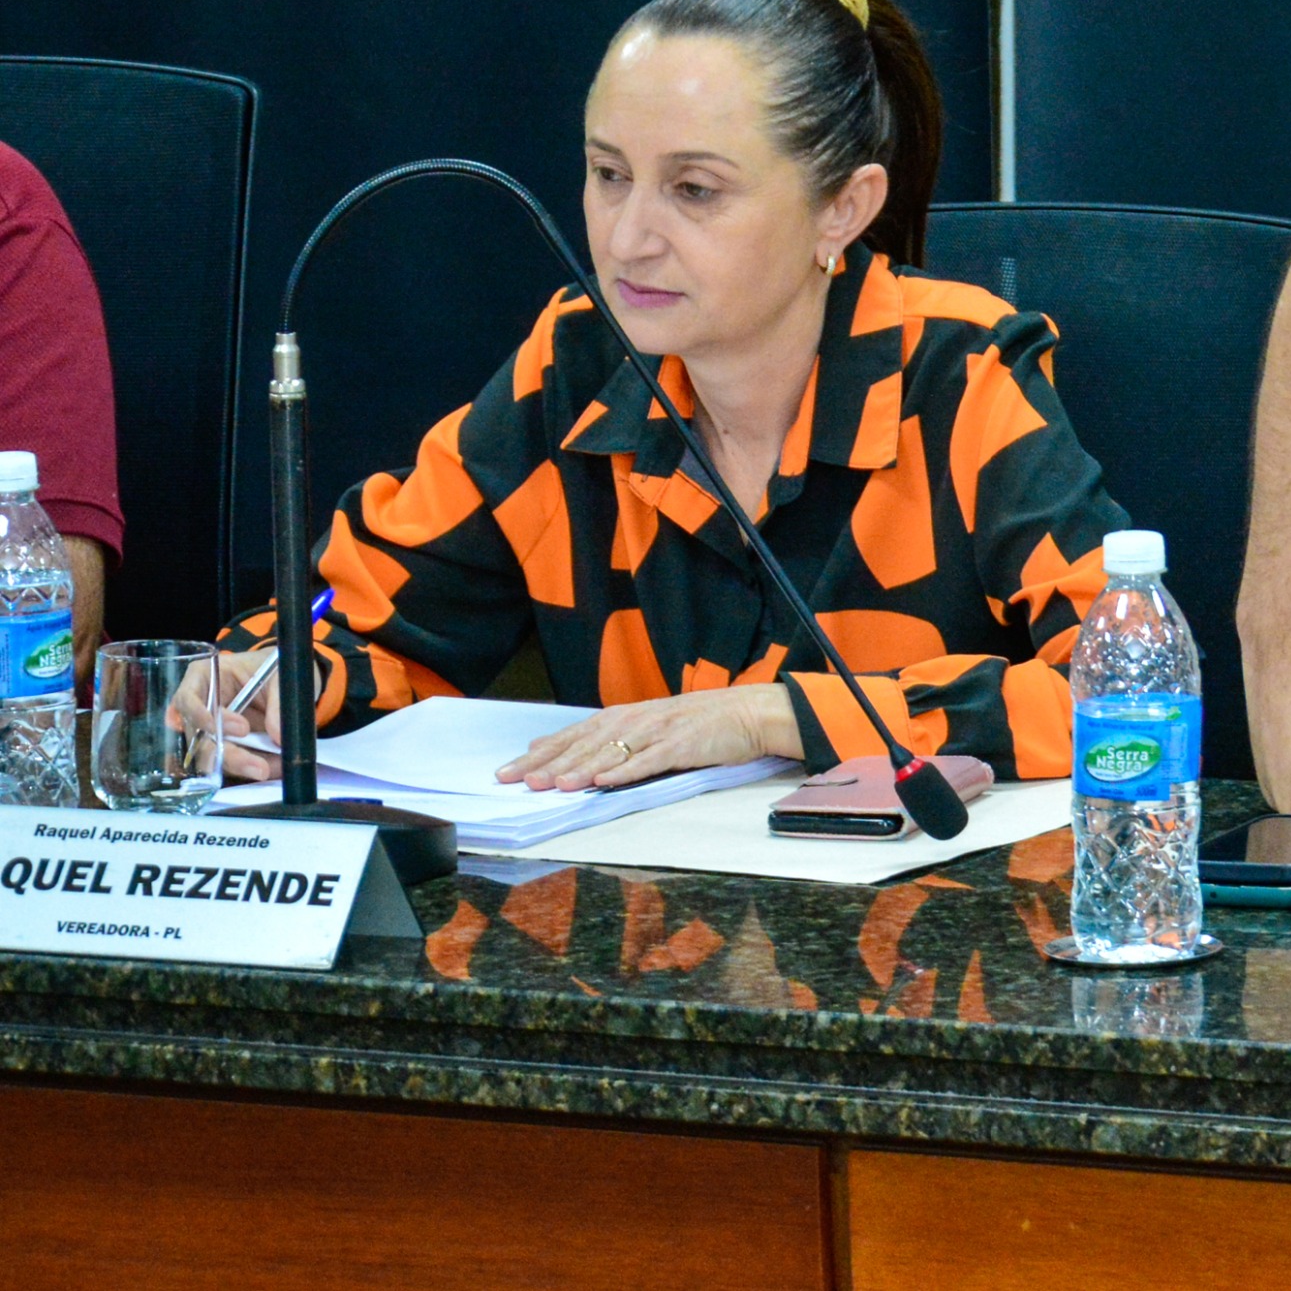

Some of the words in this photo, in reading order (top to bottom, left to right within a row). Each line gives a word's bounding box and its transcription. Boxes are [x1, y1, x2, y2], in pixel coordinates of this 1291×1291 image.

[1106, 746, 1149, 761] Serra
[1096, 756, 1143, 774] Negra
[33, 823, 97, 841] Raquel
[99, 827, 189, 845] Aparecida
[193, 831, 270, 849] Rezende
[1, 856, 112, 896] QUEL
[126, 863, 341, 907] REZENDE
[57, 920, 150, 938] VEREADORA
[162, 926, 182, 940] PL
